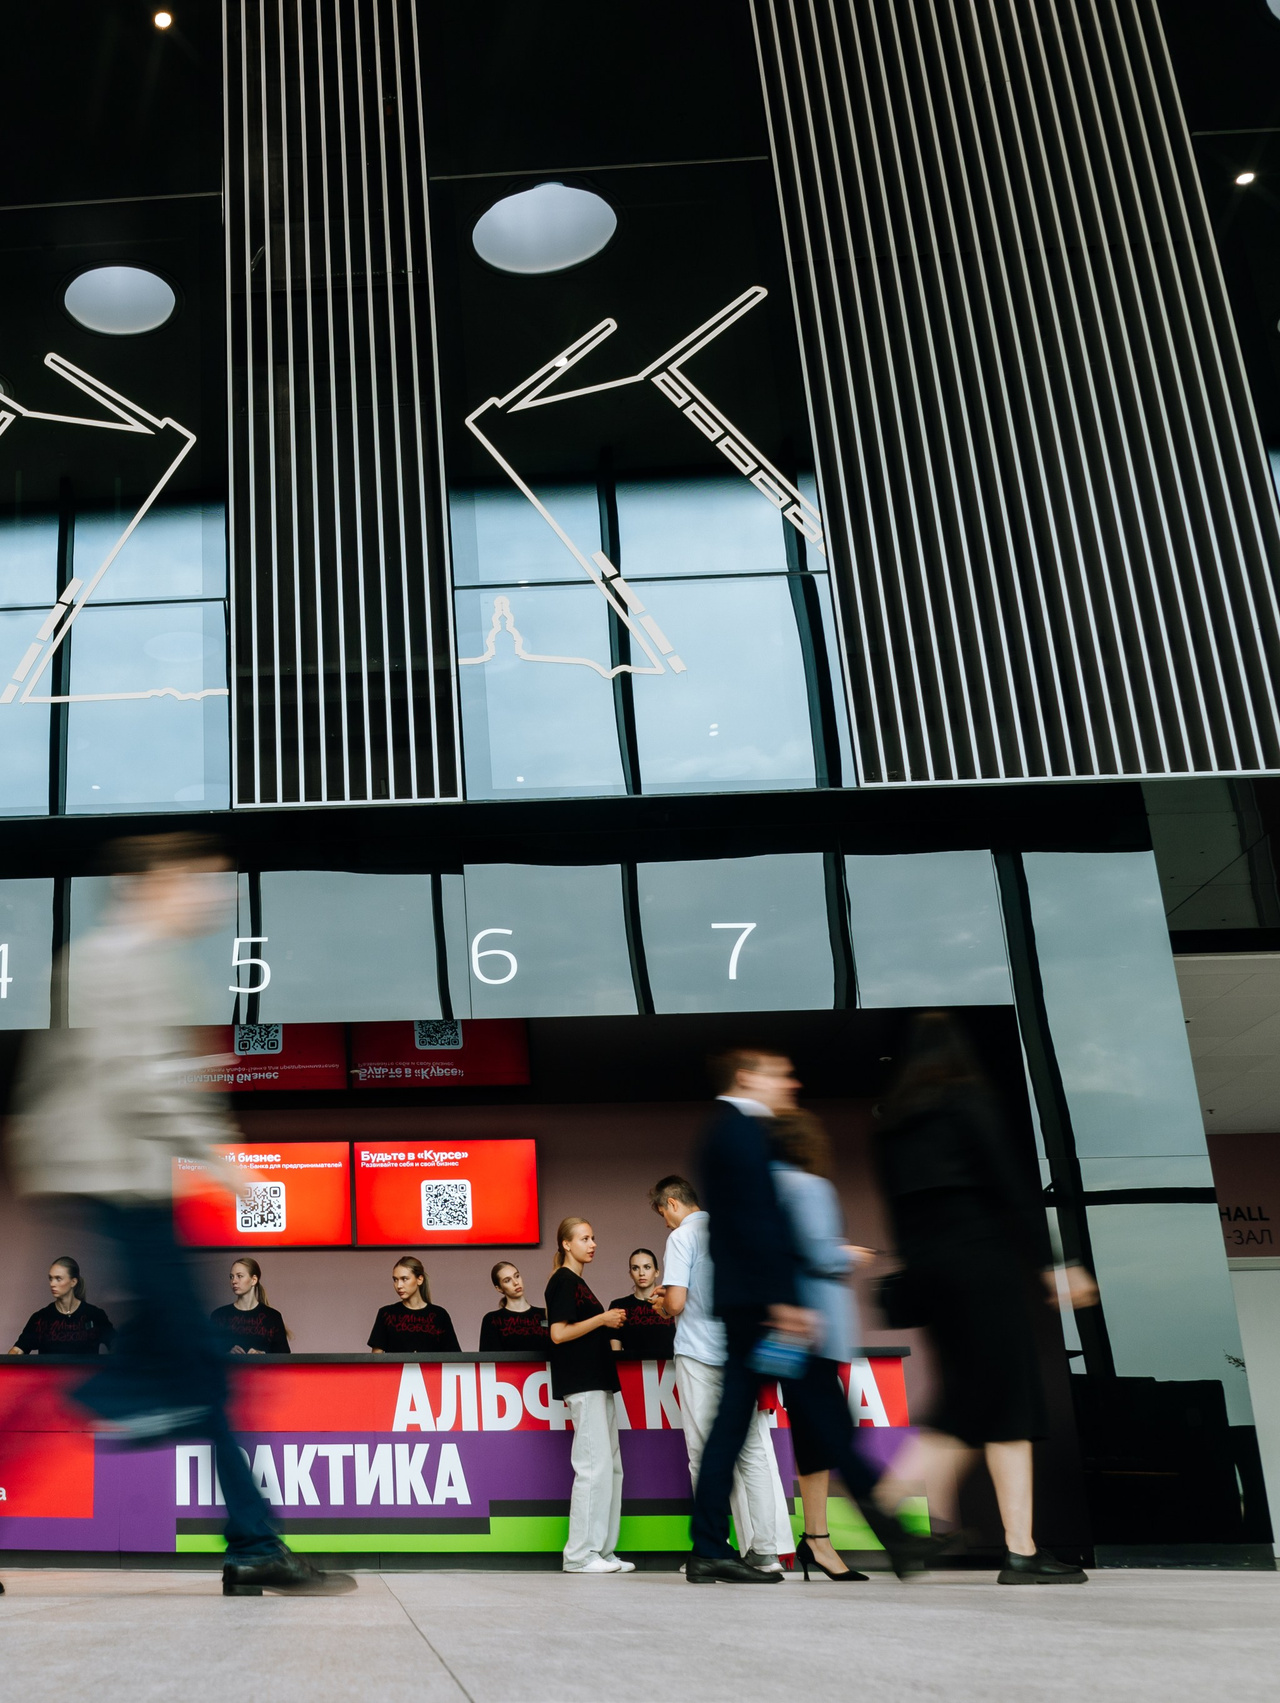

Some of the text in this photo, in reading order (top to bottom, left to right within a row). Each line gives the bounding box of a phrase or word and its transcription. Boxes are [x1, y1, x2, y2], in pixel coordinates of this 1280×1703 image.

[228, 936, 272, 994] 5
[471, 928, 518, 985] 6
[710, 922, 757, 980] 7
[237, 1152, 281, 1163] бизнес
[361, 1150, 469, 1163] Будьте в «Курсе»
[1218, 1206, 1270, 1221] HALL
[392, 1361, 632, 1432] АЛЬФ
[176, 1443, 472, 1506] ПАКТИКА
